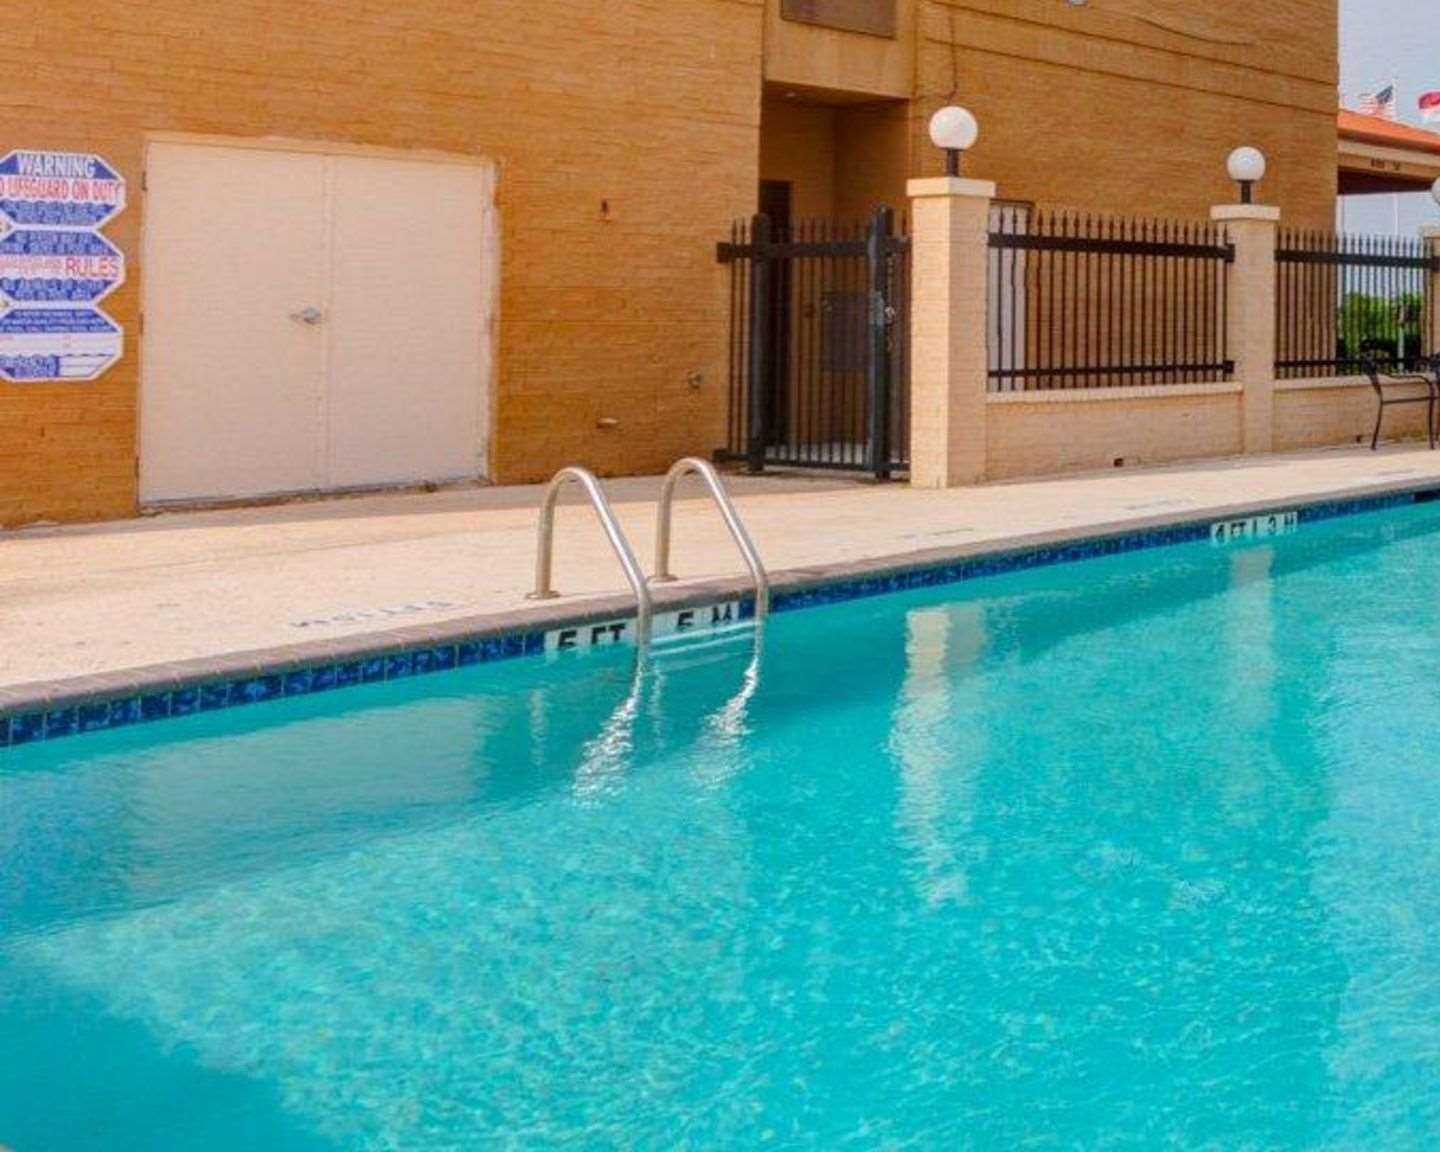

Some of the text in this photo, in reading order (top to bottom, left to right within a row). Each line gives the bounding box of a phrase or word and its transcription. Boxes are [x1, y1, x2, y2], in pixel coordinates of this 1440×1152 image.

[16, 152, 97, 178] WARNING
[8, 178, 68, 199] LIFEGUARD
[72, 179, 90, 200] ON
[92, 179, 121, 202] DUTY
[65, 256, 119, 278] RULES
